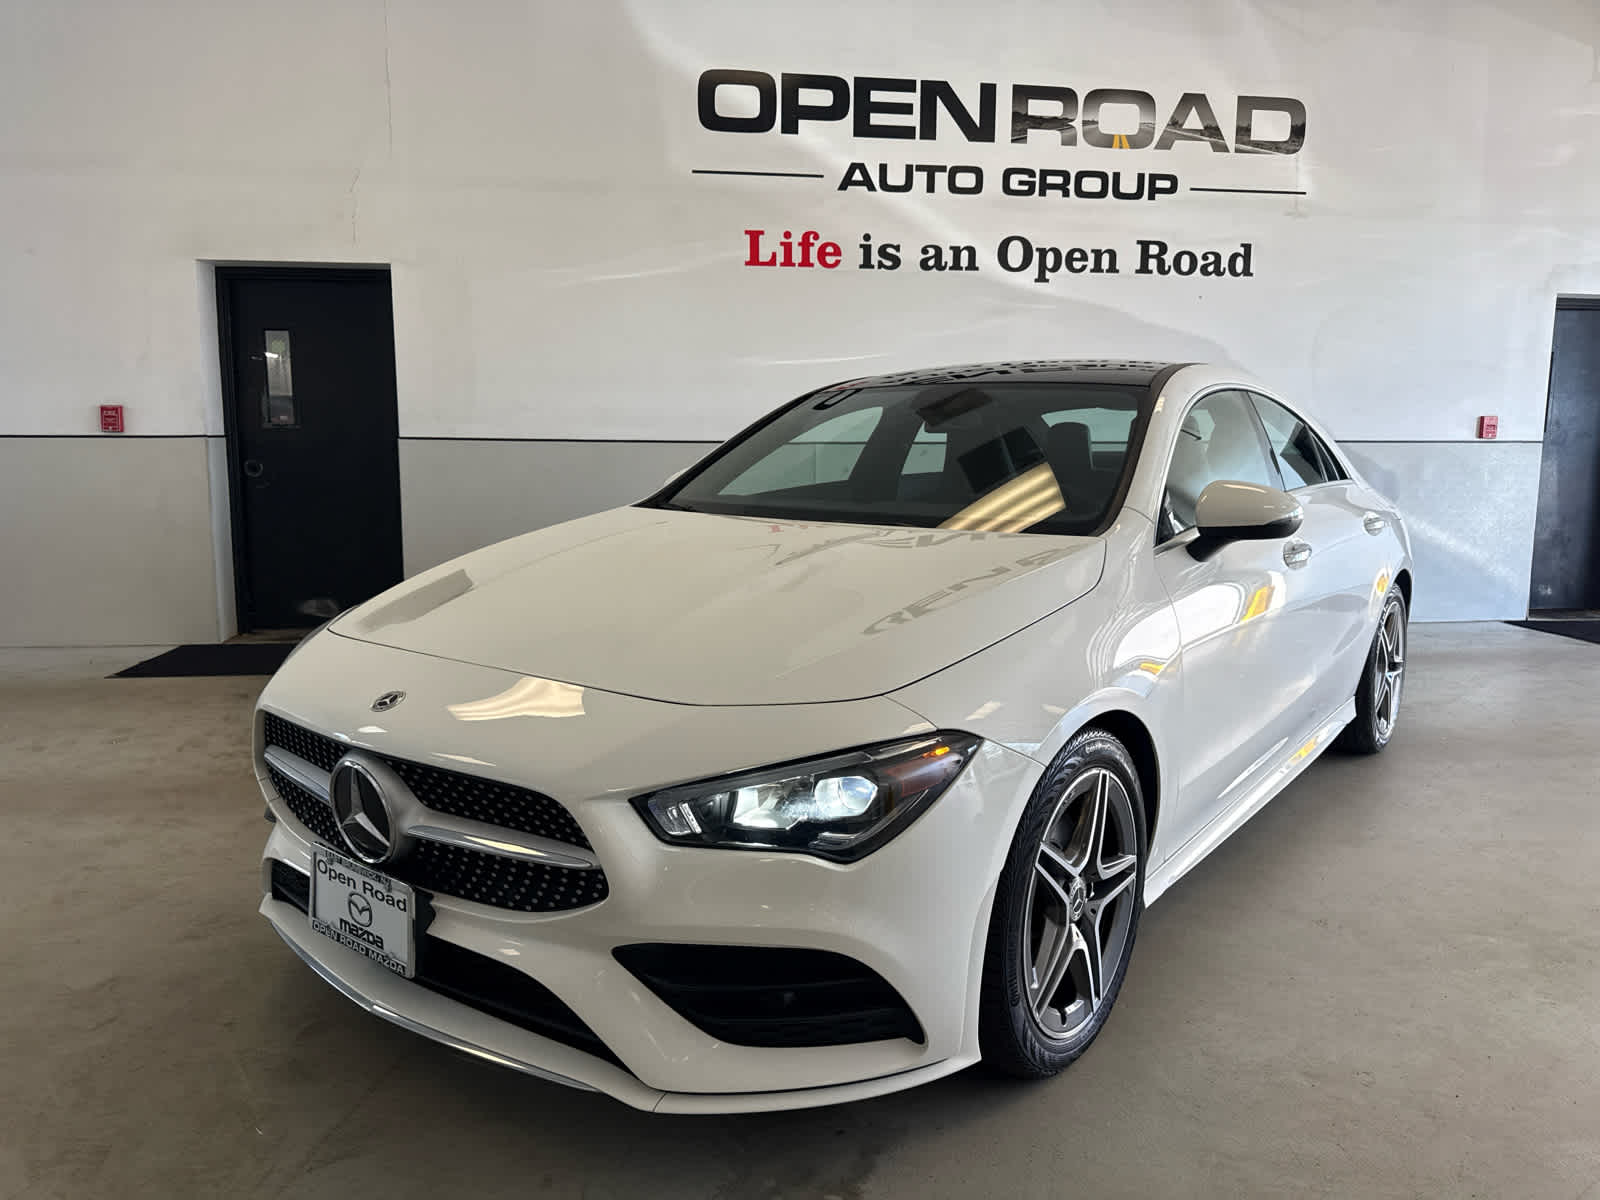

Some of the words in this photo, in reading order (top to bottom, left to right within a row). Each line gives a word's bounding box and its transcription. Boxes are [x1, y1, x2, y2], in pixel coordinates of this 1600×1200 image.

[697, 69, 997, 143] OPEN
[1010, 83, 1307, 156] ROAD
[837, 162, 984, 196] AUTO
[1001, 167, 1179, 201] GROUP
[743, 229, 843, 270] Life
[858, 232, 902, 271] is
[919, 244, 980, 272] an
[997, 235, 1120, 283] Open
[1134, 239, 1254, 278] Road
[317, 858, 356, 889] Open
[362, 880, 407, 912] Road
[312, 920, 338, 941] OPEN
[340, 935, 367, 954] ROAD
[368, 949, 405, 975] MAZDA
